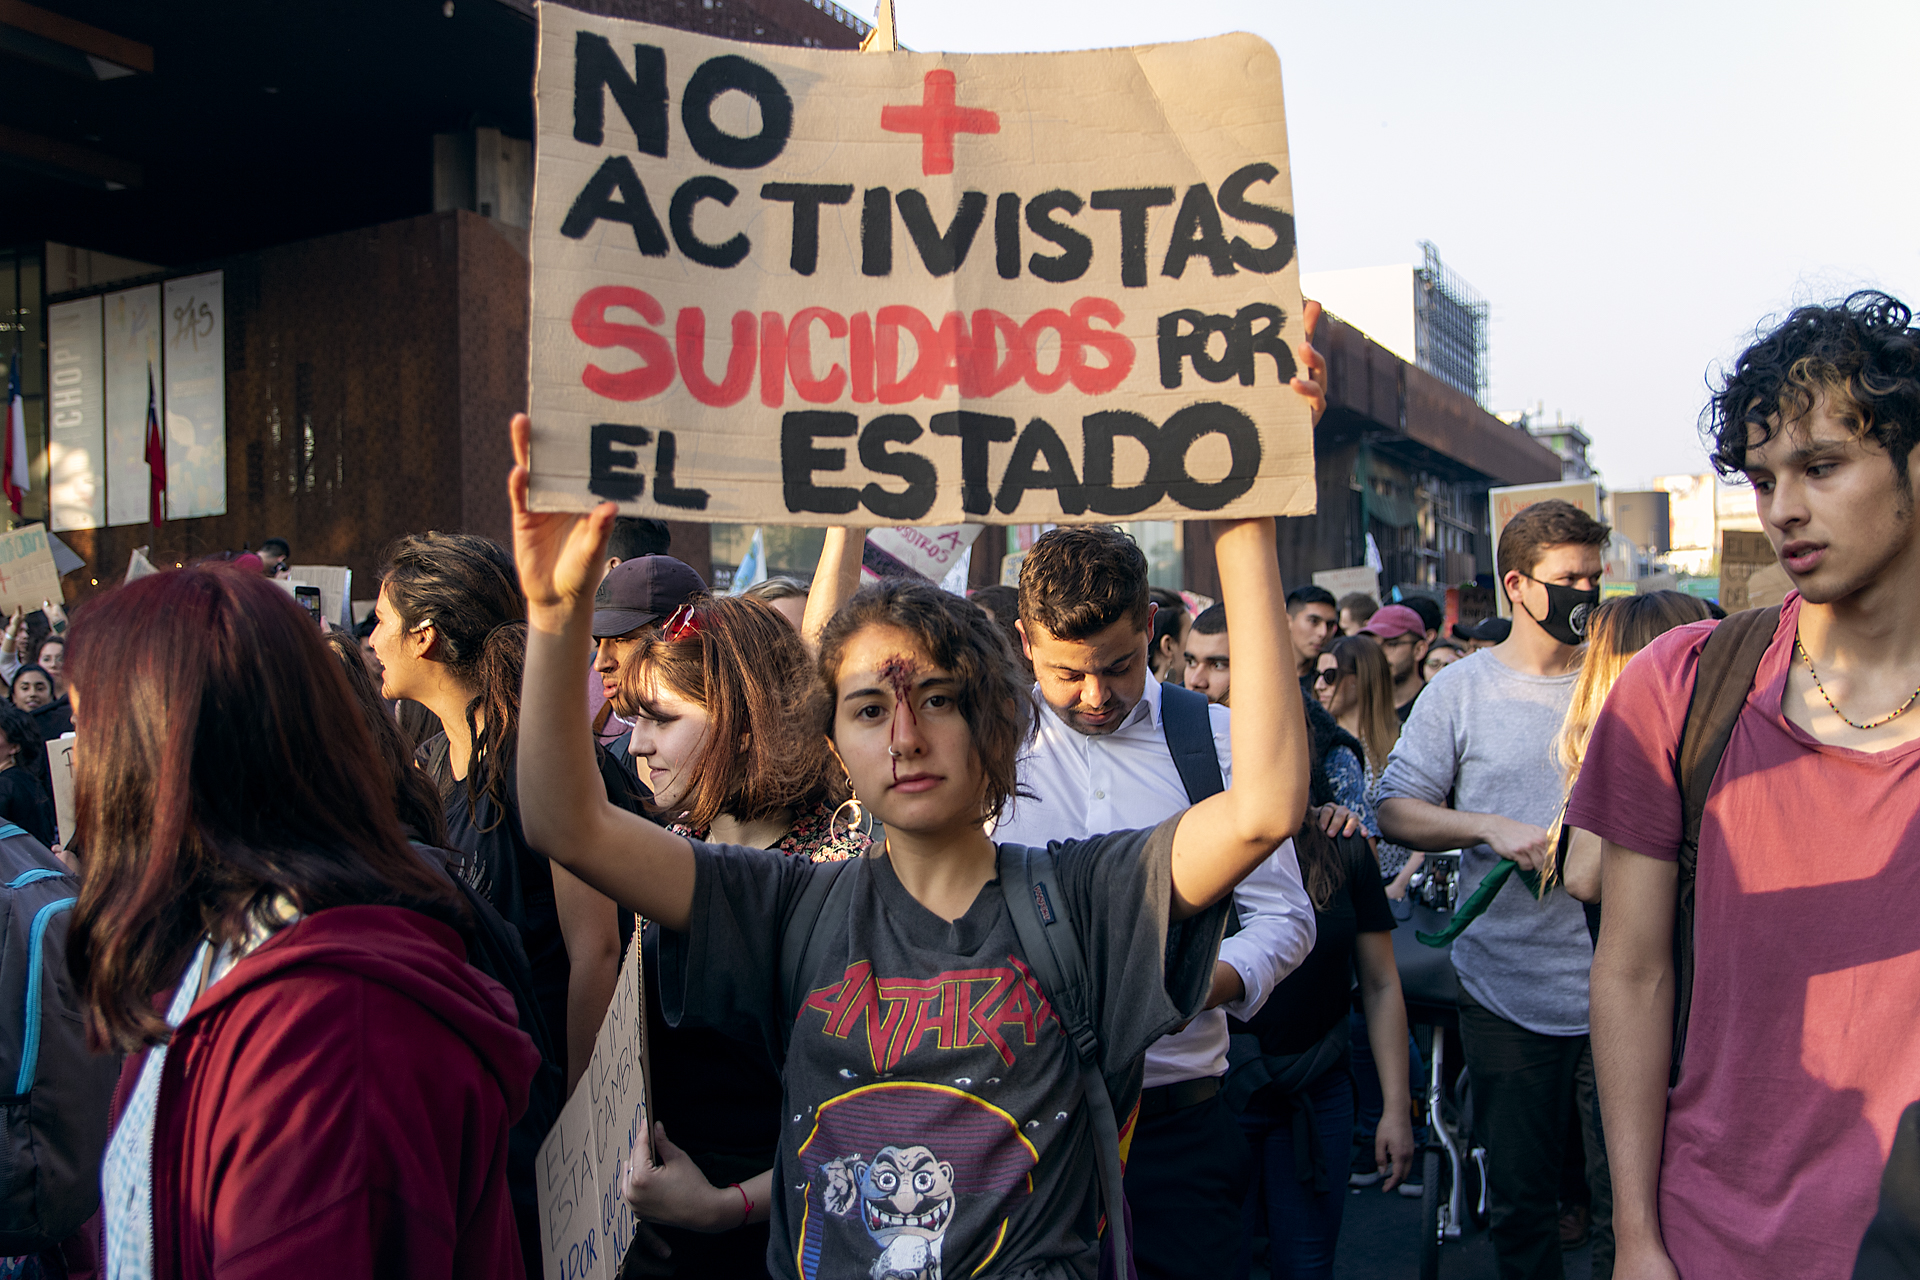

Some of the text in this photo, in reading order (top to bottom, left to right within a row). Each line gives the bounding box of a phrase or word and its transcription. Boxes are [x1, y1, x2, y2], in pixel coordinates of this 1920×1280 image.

[573, 30, 794, 170] NO
[560, 155, 1297, 288] ACTIVISTAS
[571, 285, 1298, 408] SUICIDADOS POR
[587, 400, 1263, 520] EL ESTADO
[545, 968, 634, 1193] EL CLIMA
[548, 1128, 594, 1254] ESTÁ
[602, 1146, 623, 1236] QUÉ
